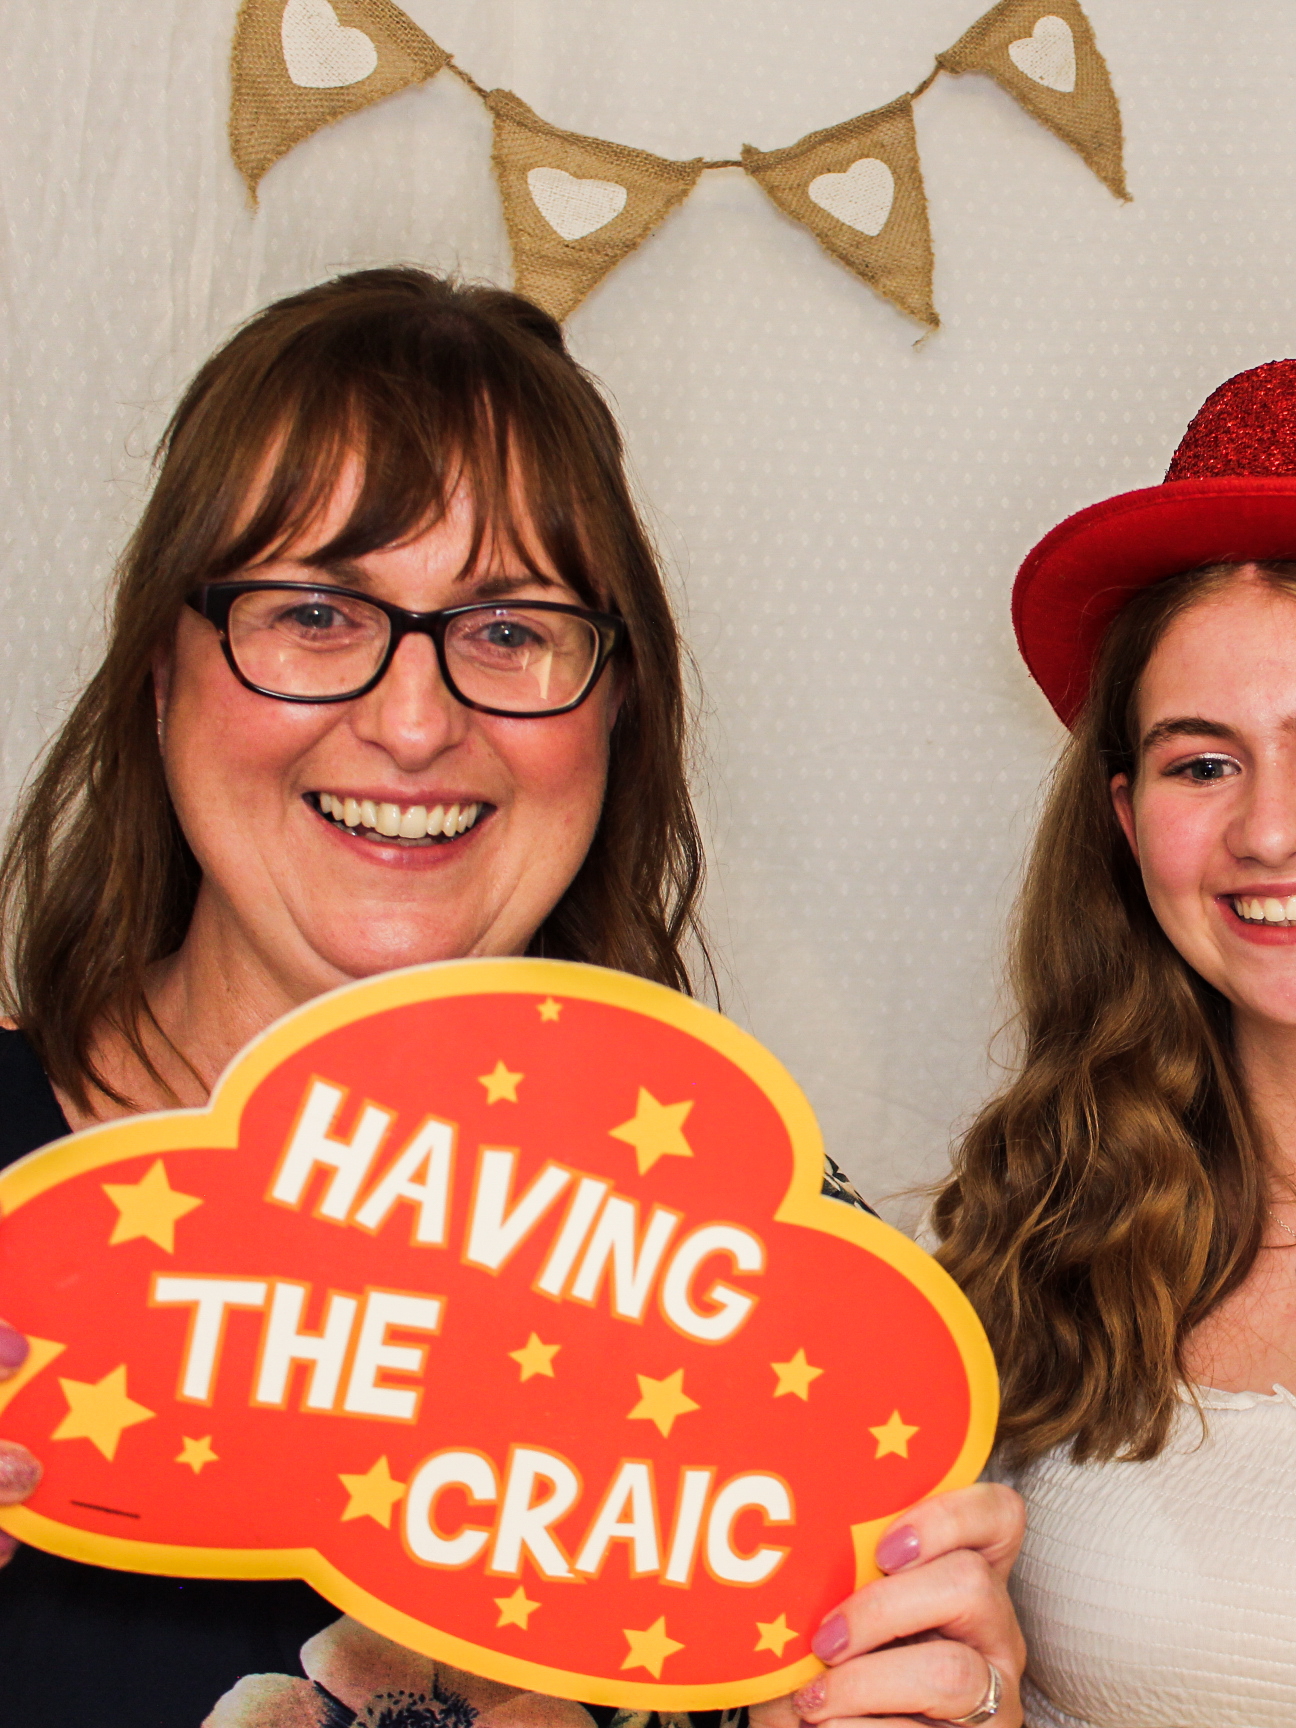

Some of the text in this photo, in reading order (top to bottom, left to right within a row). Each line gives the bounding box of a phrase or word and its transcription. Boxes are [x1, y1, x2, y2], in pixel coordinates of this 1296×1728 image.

[269, 1079, 765, 1343] HAVING
[152, 1275, 443, 1421] THE
[403, 1446, 793, 1586] CRAIC
